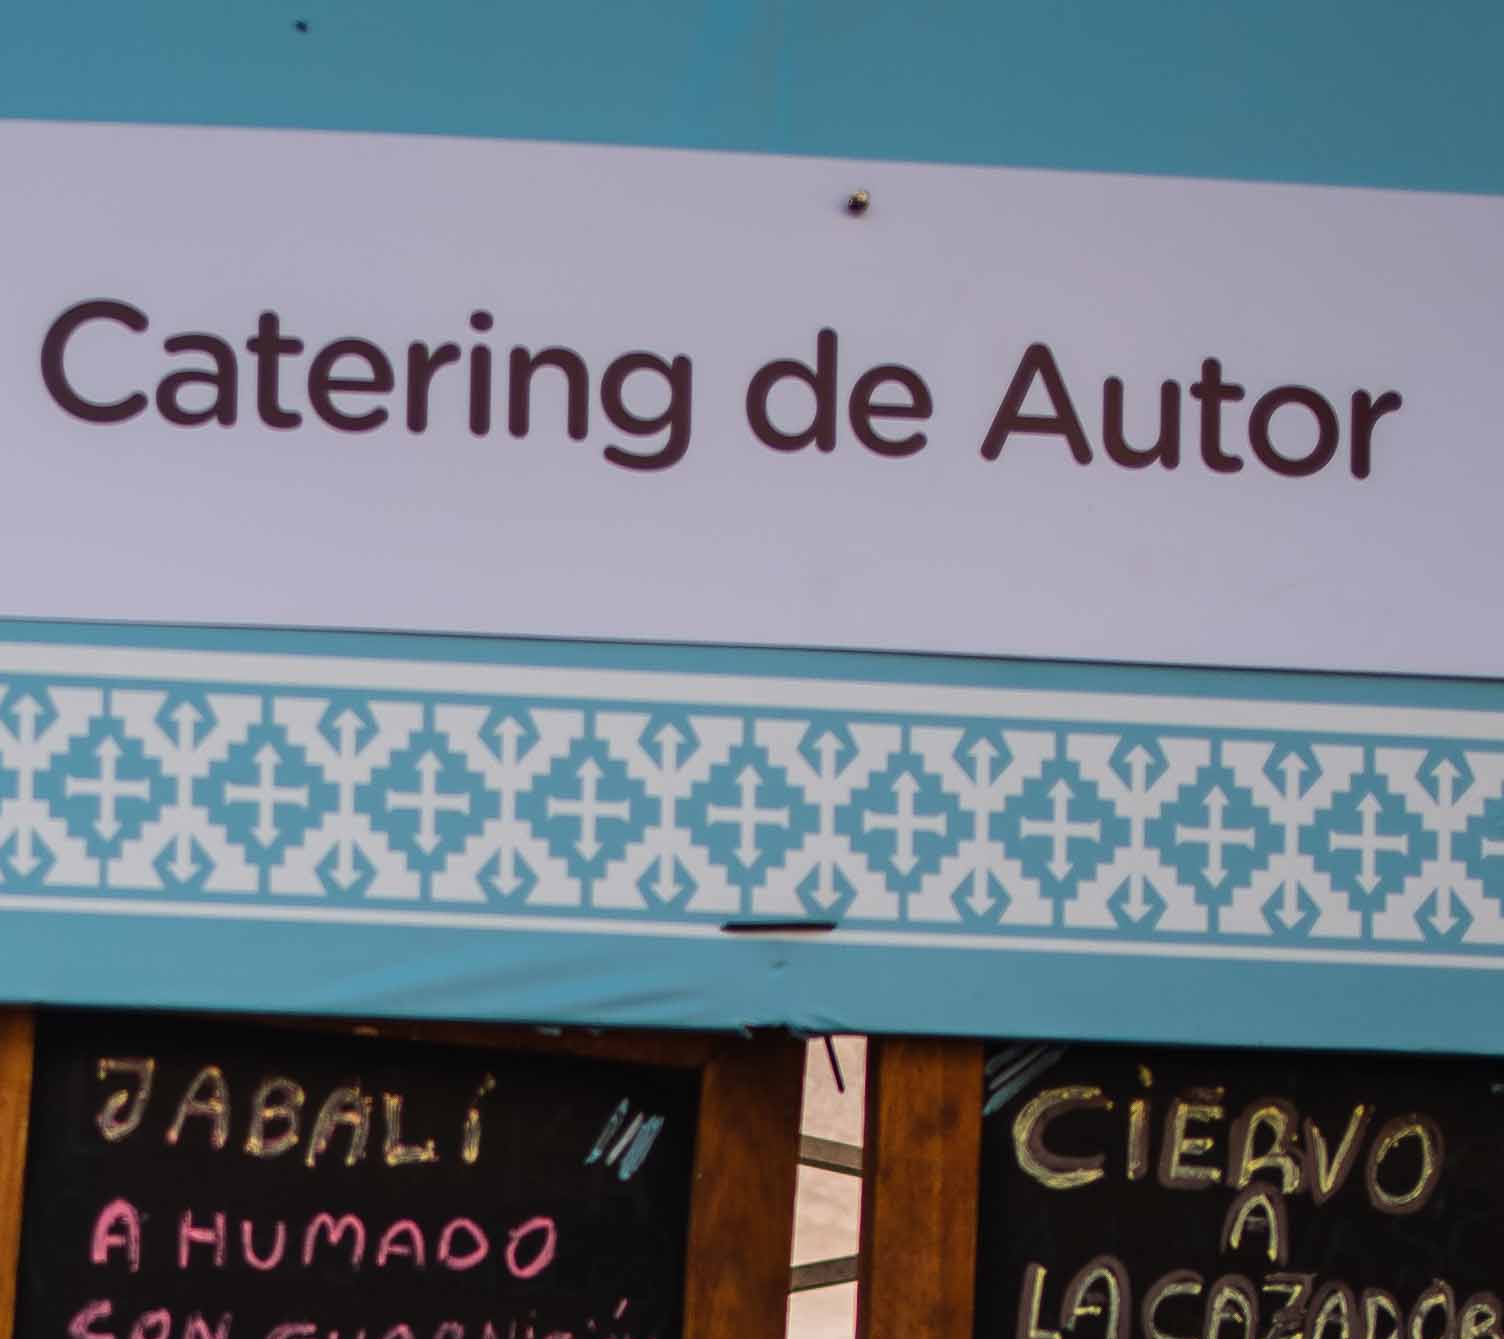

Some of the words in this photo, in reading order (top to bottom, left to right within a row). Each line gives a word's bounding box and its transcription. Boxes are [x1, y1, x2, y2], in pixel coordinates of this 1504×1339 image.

[36, 298, 694, 472] Catering
[744, 326, 934, 456] de
[980, 340, 1404, 480] Autor
[1222, 1184, 1288, 1264] A
